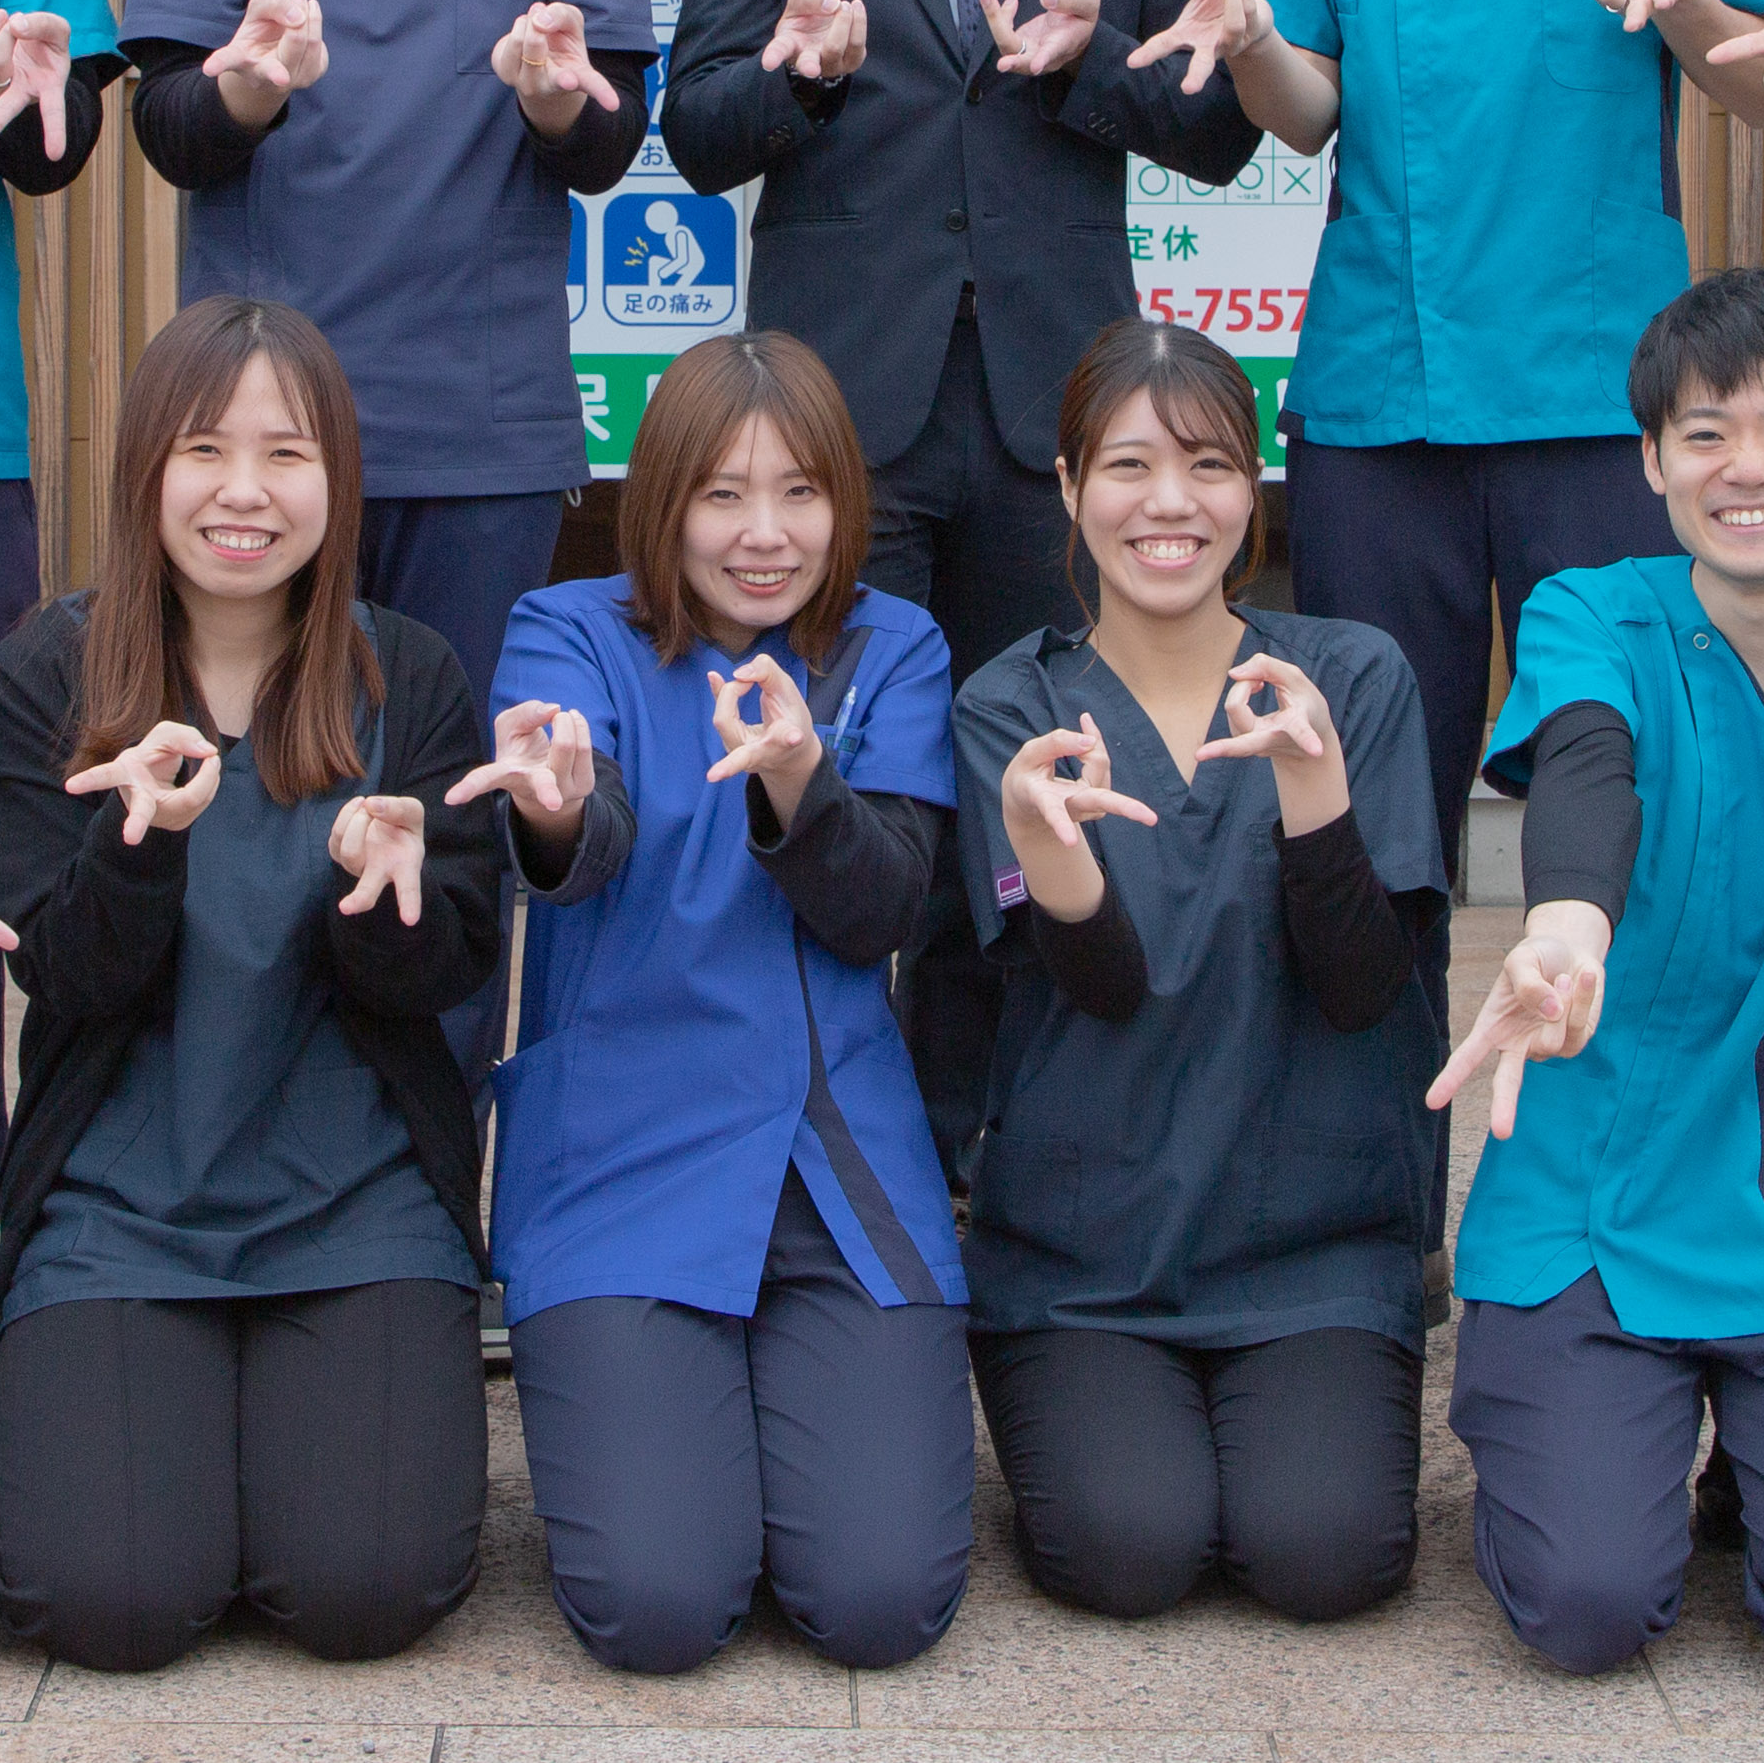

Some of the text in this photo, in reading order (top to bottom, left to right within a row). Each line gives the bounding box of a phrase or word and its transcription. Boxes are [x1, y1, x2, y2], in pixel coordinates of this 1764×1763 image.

[641, 142, 674, 167] お
[623, 293, 713, 315] 足の痛み
[1136, 288, 1310, 333] 5-7557
